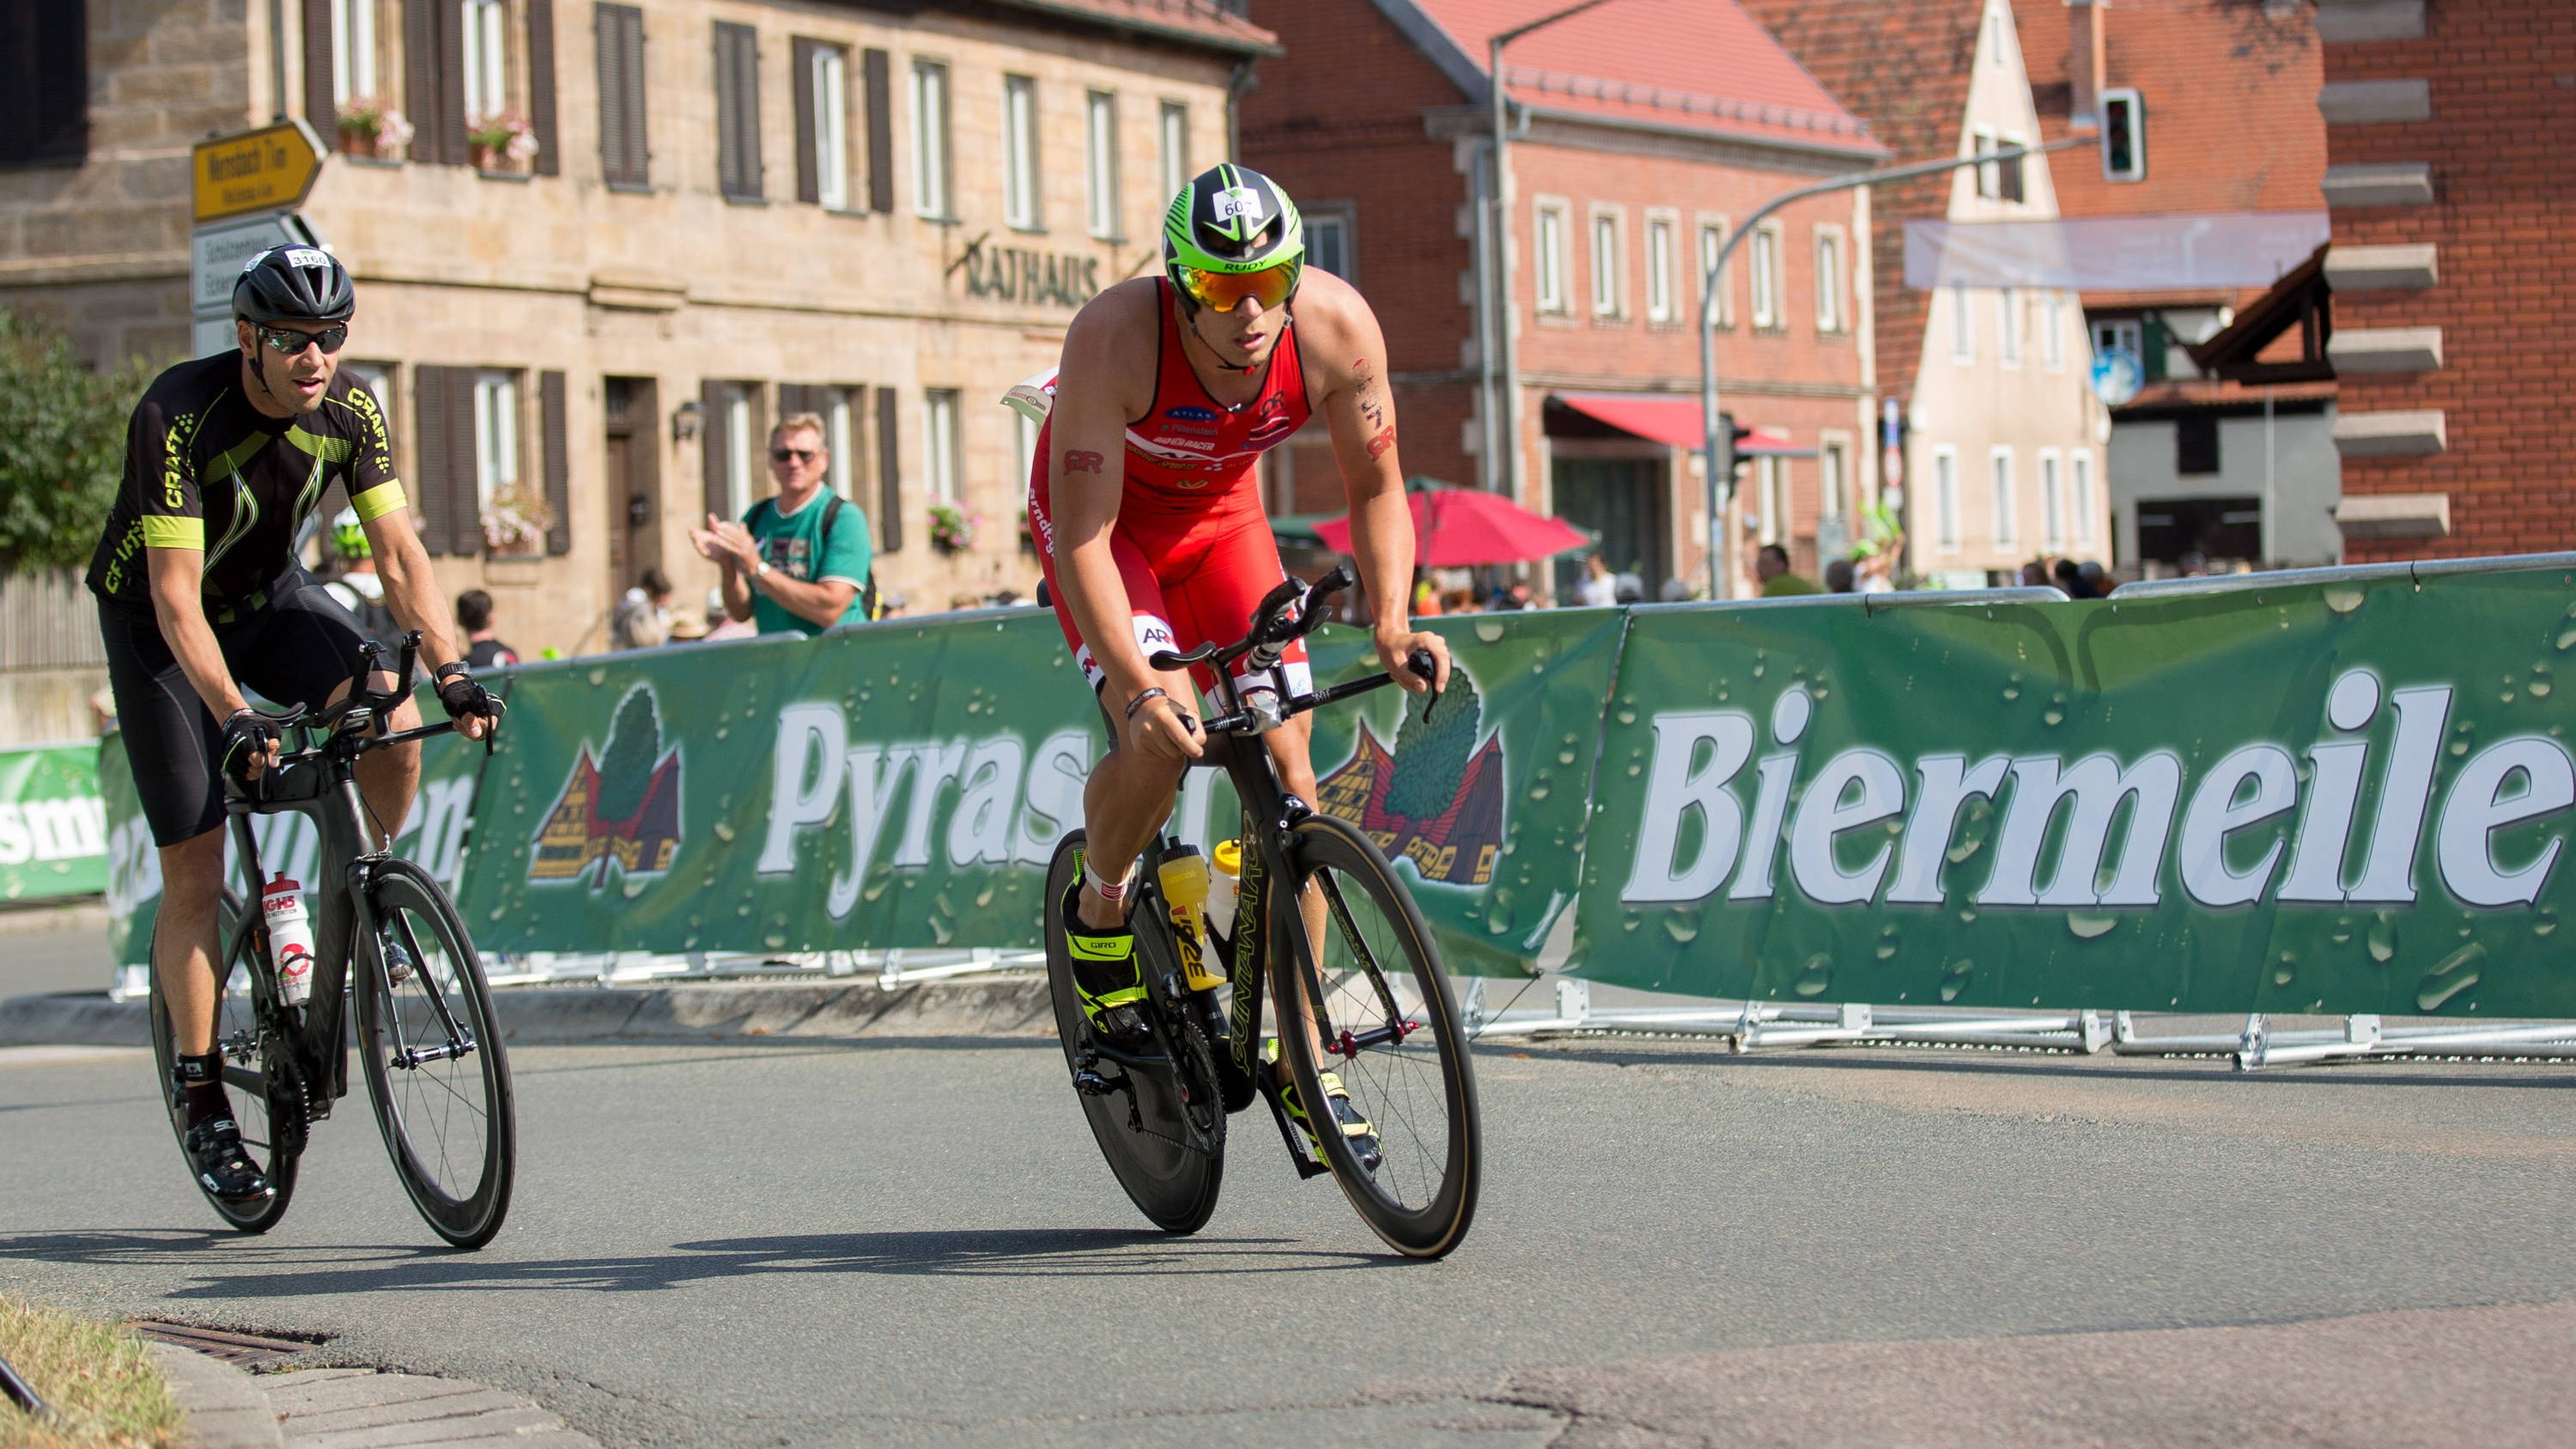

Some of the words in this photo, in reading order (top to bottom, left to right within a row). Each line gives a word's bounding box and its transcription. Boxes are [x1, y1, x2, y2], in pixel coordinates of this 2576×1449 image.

[295, 256, 326, 266] 3160
[967, 243, 1098, 307] RATHAUS
[1224, 259, 1267, 271] RUDY
[348, 387, 389, 452] CRAFT
[1172, 409, 1212, 420] ATLAS
[165, 425, 184, 508] CRAFT
[1620, 669, 2576, 910] Biermeile
